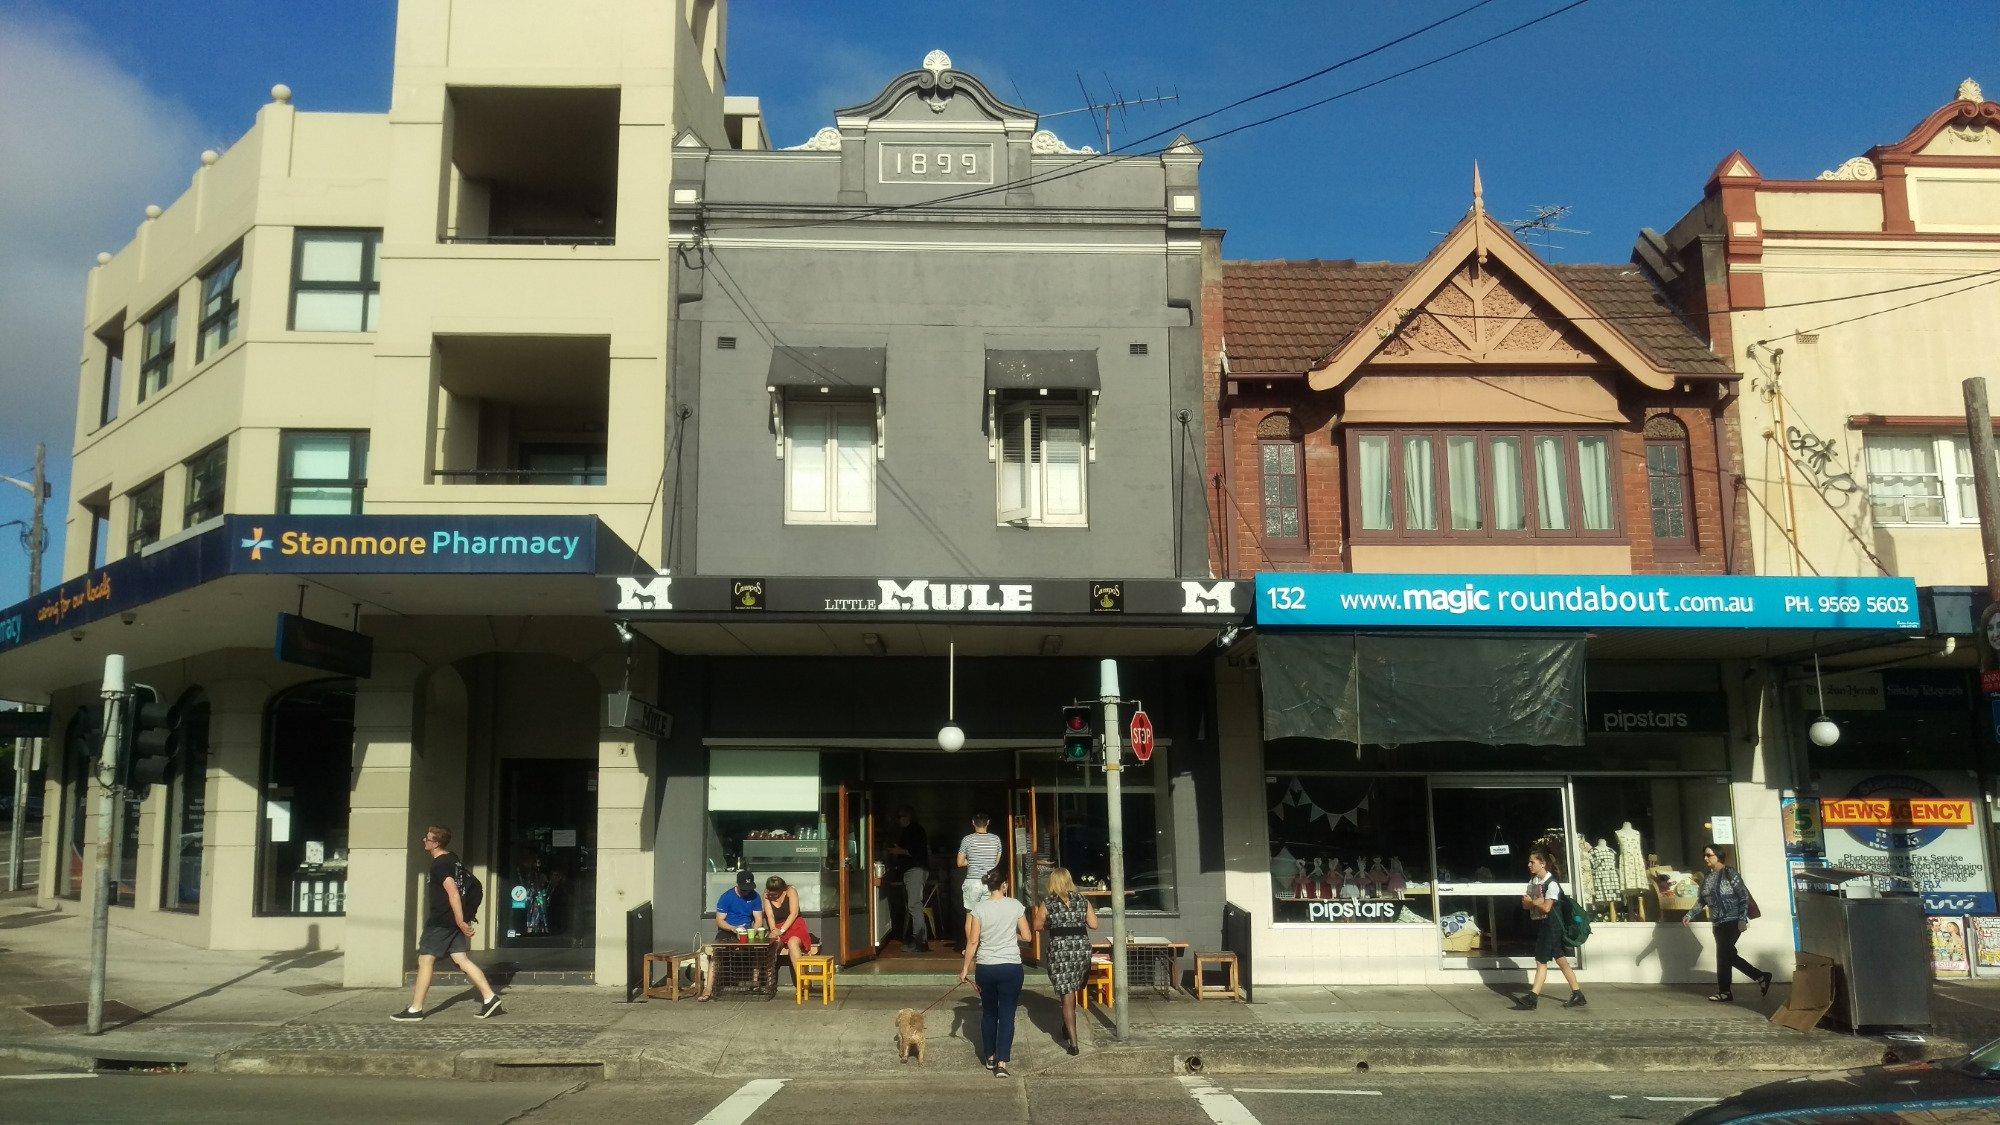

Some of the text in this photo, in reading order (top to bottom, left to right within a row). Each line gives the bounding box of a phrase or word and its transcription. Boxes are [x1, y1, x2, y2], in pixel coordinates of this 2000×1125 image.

[896, 153, 976, 175] 1899
[280, 531, 580, 560] Stanmore Pharmacy
[617, 577, 673, 610] M
[824, 580, 1032, 611] LITTLE MULE
[1181, 581, 1235, 613] M
[1267, 586, 1306, 610] 132
[1784, 595, 1812, 613] PH.
[1817, 595, 1859, 613] 9569
[1865, 595, 1908, 613] 5603
[1603, 710, 1688, 731] pipstars
[1133, 727, 1151, 744] STOP
[1829, 804, 1964, 820] NEWSAGENCY
[1309, 899, 1395, 921] pipstars
